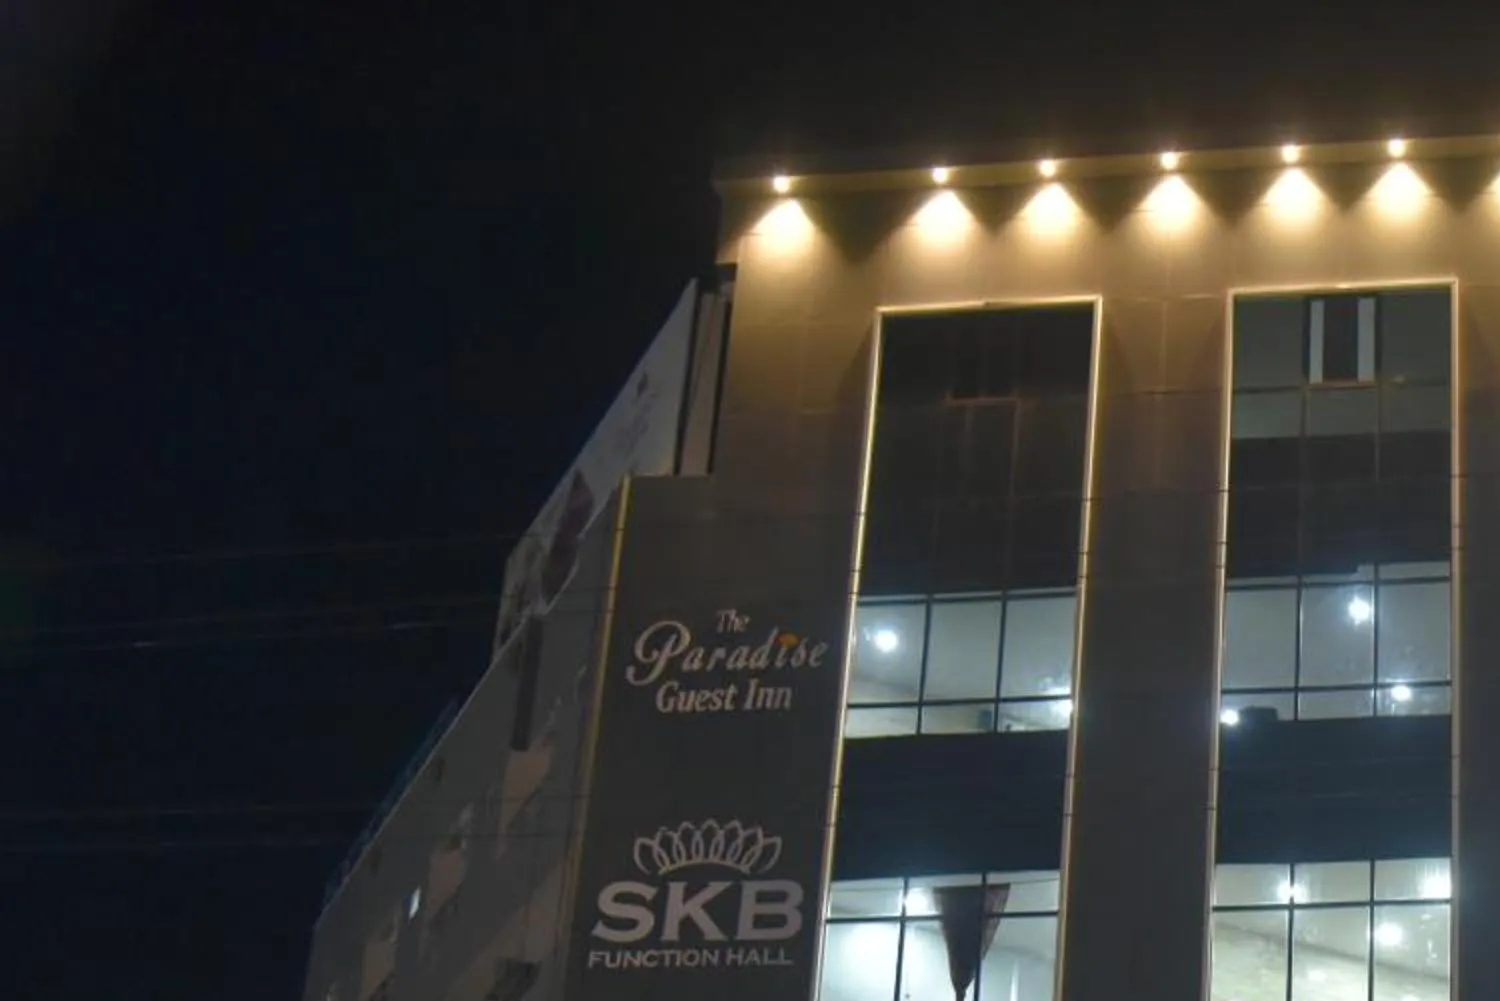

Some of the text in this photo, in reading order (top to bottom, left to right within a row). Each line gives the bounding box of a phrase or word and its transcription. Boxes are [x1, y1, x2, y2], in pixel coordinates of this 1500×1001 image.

[715, 608, 751, 634] The
[626, 620, 830, 686] Paradise
[656, 678, 793, 713] Guest Inn
[591, 880, 805, 943] SKB
[588, 947, 794, 969] FUNCTION HALL
